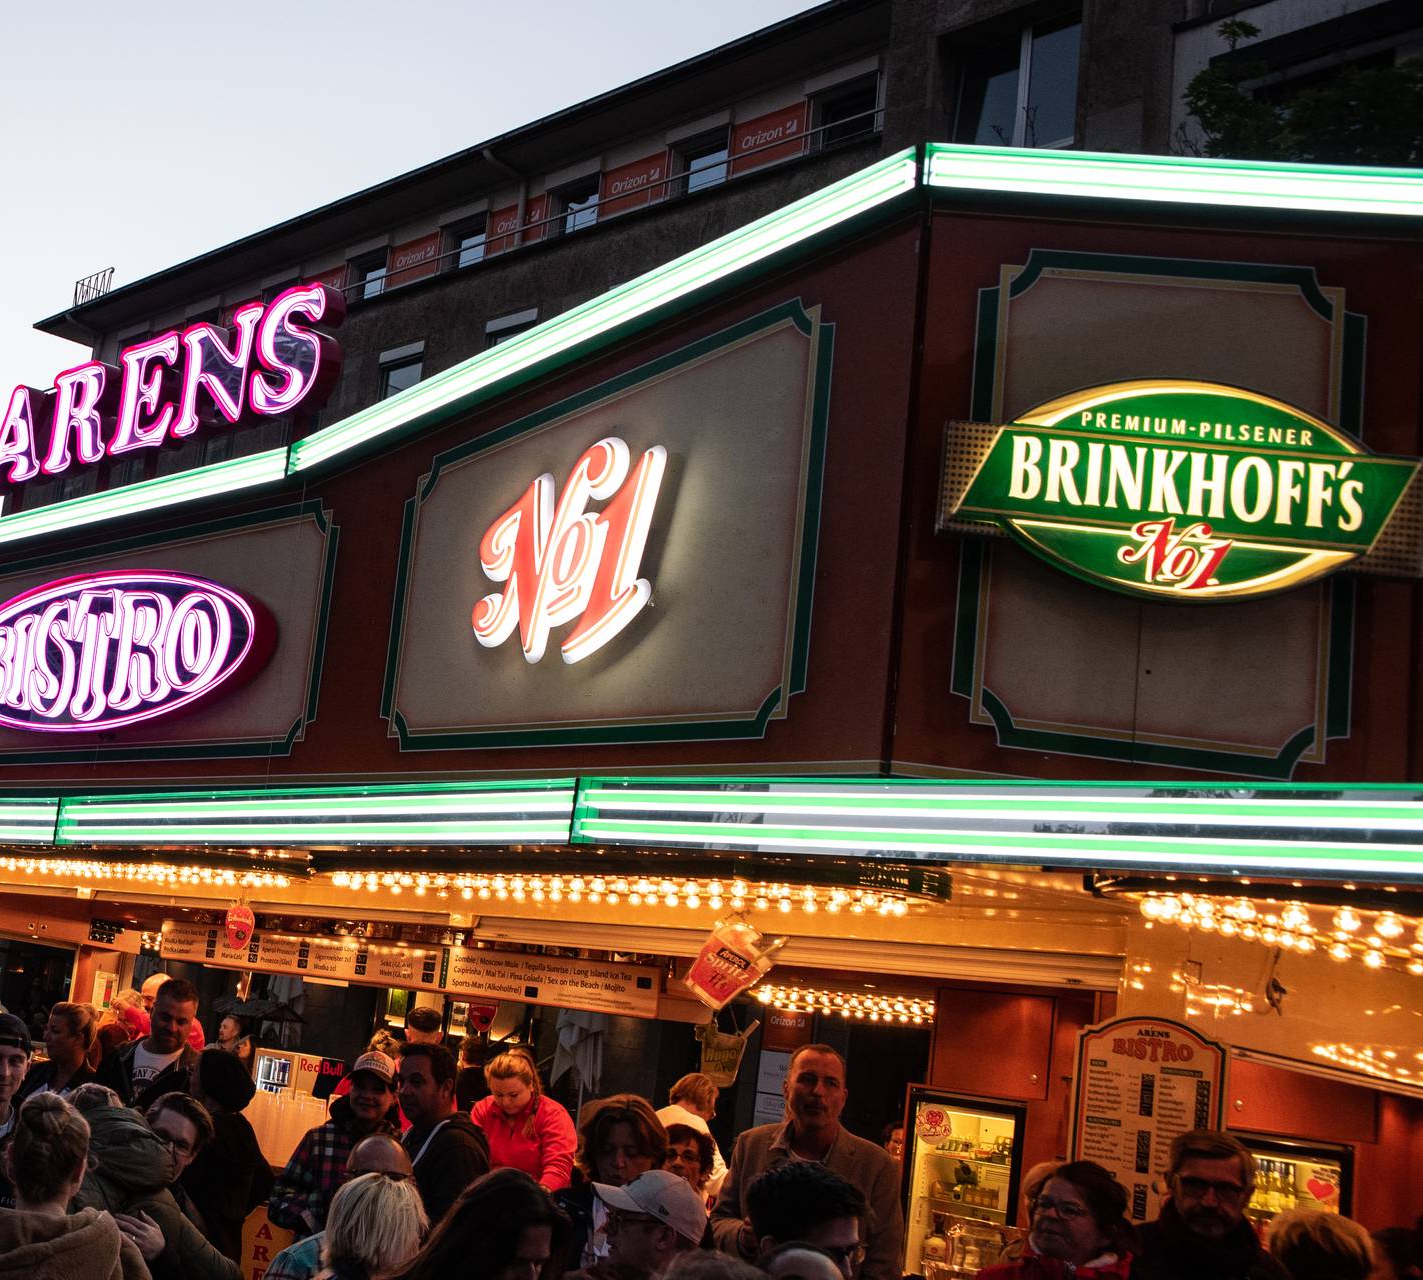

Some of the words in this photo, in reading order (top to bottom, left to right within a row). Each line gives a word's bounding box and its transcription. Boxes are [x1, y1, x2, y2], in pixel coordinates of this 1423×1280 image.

[741, 126, 783, 149] Orizon
[611, 174, 647, 194] Orizon
[396, 250, 425, 268] Orizon
[1080, 410, 1314, 448] PREMIUM-PILSENER
[455, 954, 476, 965] Zombie
[480, 958, 504, 967] Moscow
[525, 962, 546, 973] Tequila
[546, 965, 569, 974] Sunrise
[573, 968, 589, 978] Long
[590, 968, 609, 978] Island
[621, 972, 633, 981] Tea
[720, 950, 749, 968] APEROL
[452, 978, 484, 990] Sports-Man
[453, 965, 481, 976] Caipirinha
[485, 968, 496, 977] Mai
[497, 970, 506, 978] Tai
[523, 973, 544, 983] Colada
[547, 976, 558, 984] Sex
[569, 978, 579, 987] the
[580, 980, 599, 989] Beach
[604, 983, 626, 993] Mojito
[771, 1015, 796, 1027] Orizon
[1136, 1028, 1170, 1038] ARENS
[1111, 1038, 1194, 1063] BISTRO
[300, 1058, 321, 1073] Red
[322, 1061, 344, 1077] Bull
